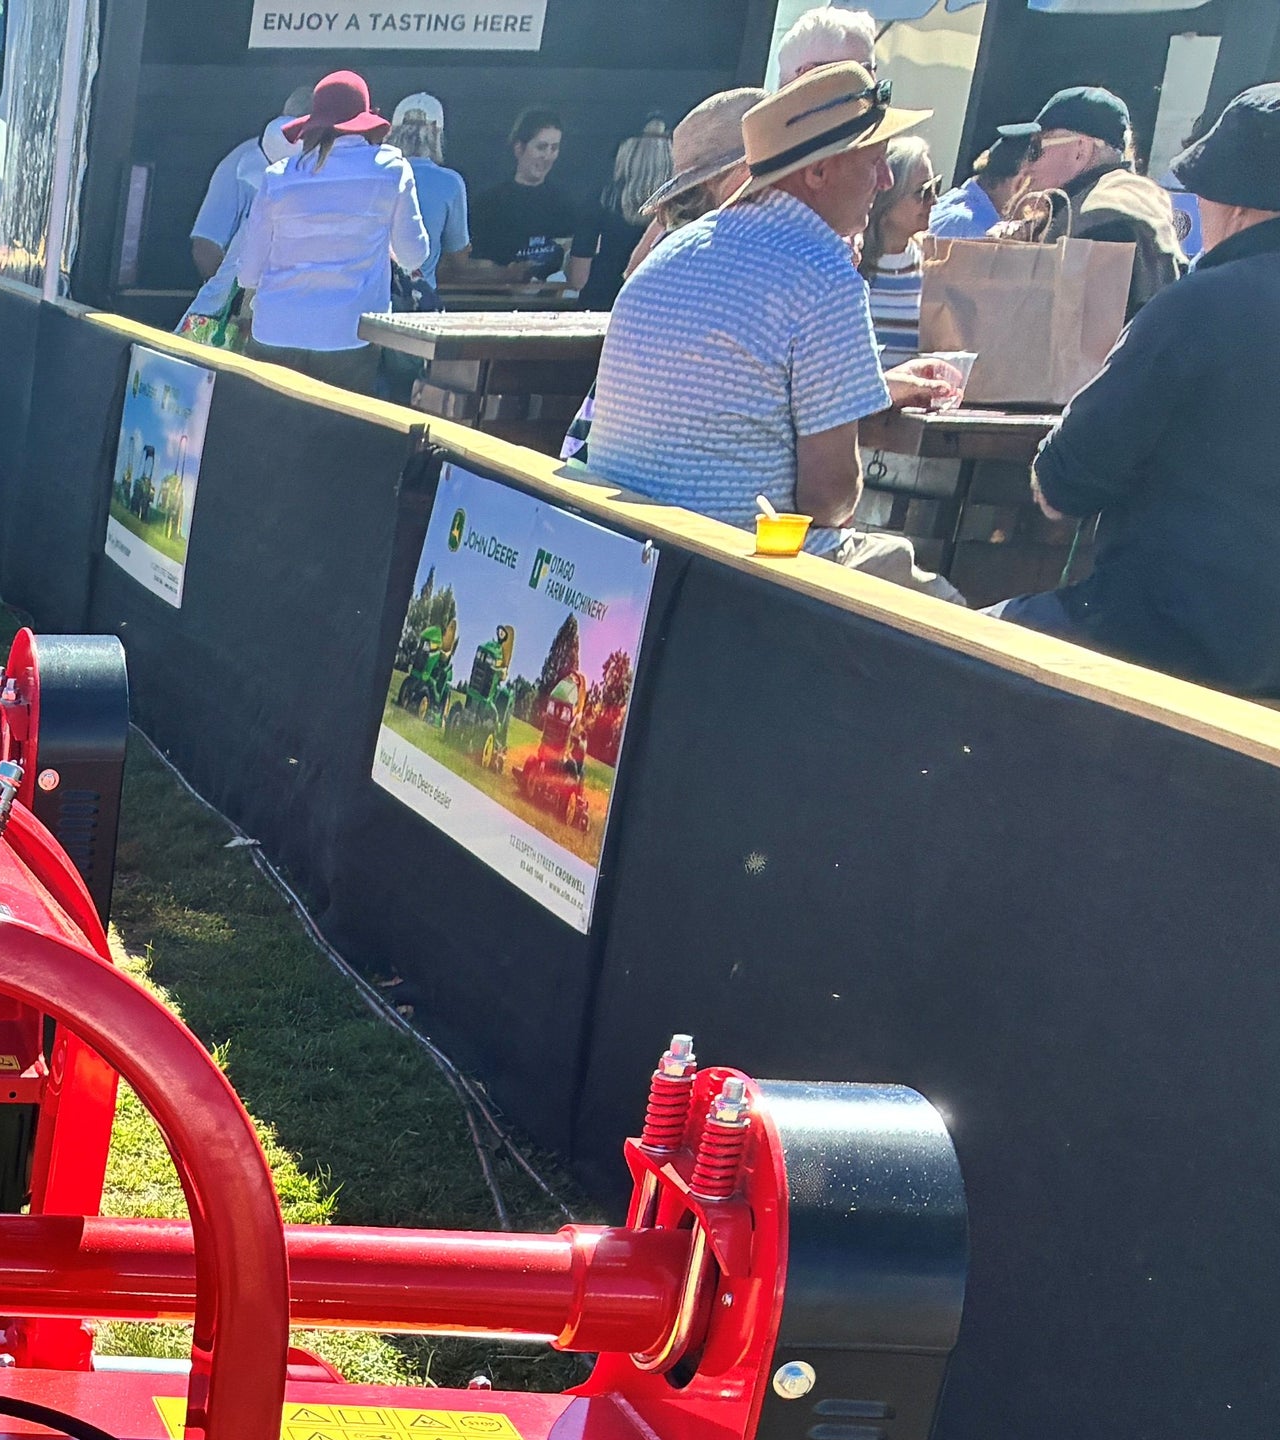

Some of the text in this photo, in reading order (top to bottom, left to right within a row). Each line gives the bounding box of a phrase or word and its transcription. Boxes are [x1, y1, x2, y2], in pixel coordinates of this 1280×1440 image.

[263, 13, 534, 32] ENJOY A TASTING HERE
[463, 526, 519, 570] JOHN DEERE
[550, 555, 576, 582] OTAGO
[545, 578, 609, 622] FARM MACHINERY
[554, 865, 586, 896] CROMWELL
